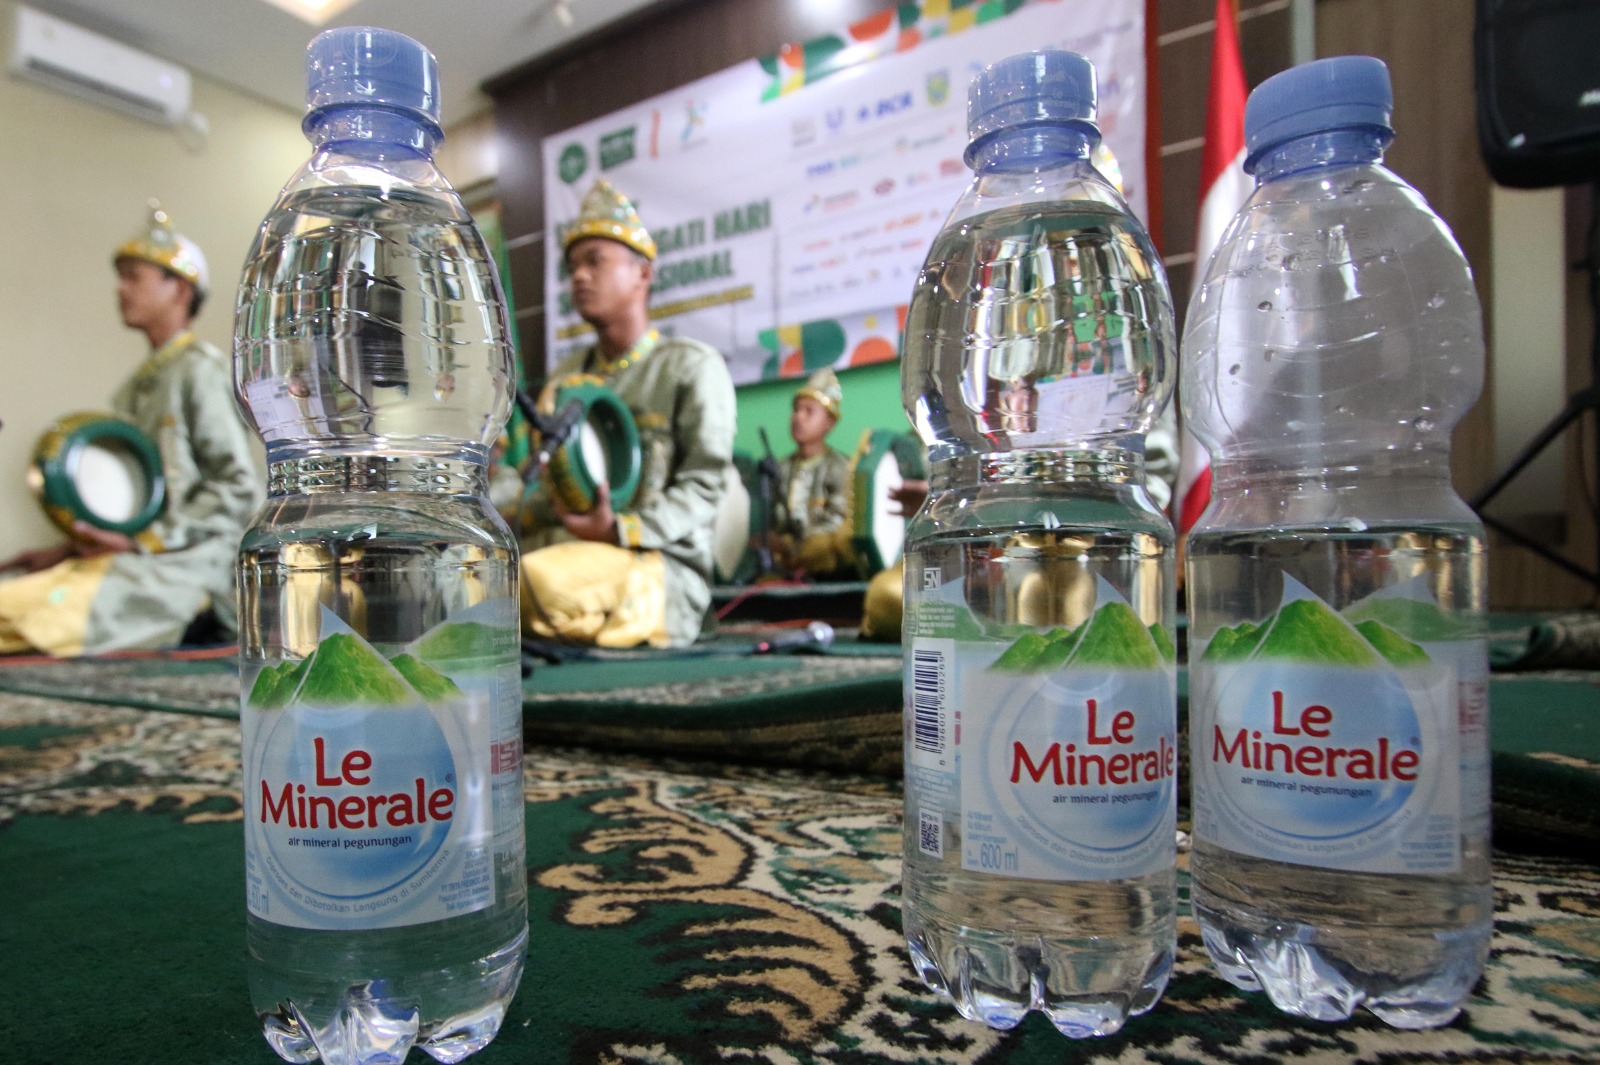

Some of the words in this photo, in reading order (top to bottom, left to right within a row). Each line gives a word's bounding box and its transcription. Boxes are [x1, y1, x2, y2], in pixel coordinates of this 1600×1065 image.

[713, 198, 771, 240] HARI
[923, 567, 941, 591] SNI
[1087, 699, 1135, 746] Le
[1272, 690, 1333, 738] Le
[314, 737, 372, 787] Le
[1010, 737, 1174, 786] Minerale
[1212, 724, 1420, 782] Minerale
[260, 777, 454, 829] Minerale
[1053, 794, 1066, 803] air
[1070, 794, 1110, 804] mineral
[1241, 776, 1254, 784] air
[1257, 779, 1297, 790] mineral
[1300, 784, 1373, 798] pegunungan
[288, 835, 301, 847] air
[303, 837, 341, 849] mineral
[343, 834, 413, 850] pegunungan
[980, 842, 1002, 869] 600
[1004, 846, 1019, 871] ml
[353, 893, 399, 912] Langsung
[400, 888, 409, 898] di
[409, 849, 450, 891] Sumbernya
